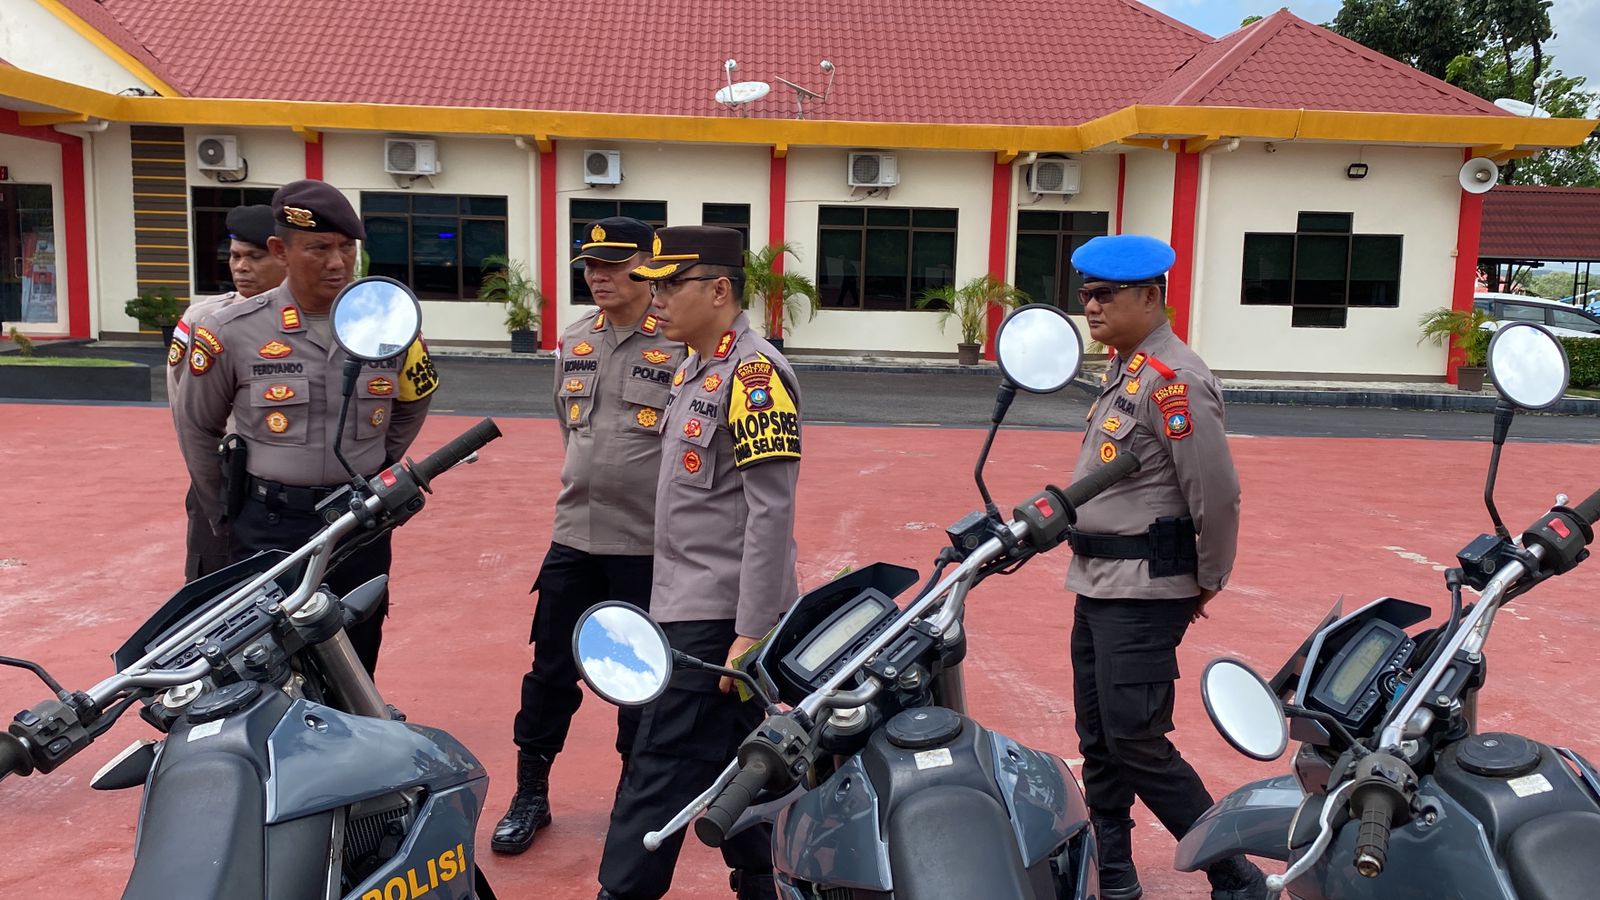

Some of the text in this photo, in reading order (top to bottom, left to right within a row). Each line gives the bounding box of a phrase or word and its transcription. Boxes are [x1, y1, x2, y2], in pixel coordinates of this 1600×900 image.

[633, 366, 671, 384] POLRI
[737, 363, 771, 374] POLRES
[689, 399, 718, 418] POLRI
[1114, 395, 1136, 415] POLRI
[752, 436, 785, 455] SELIGI
